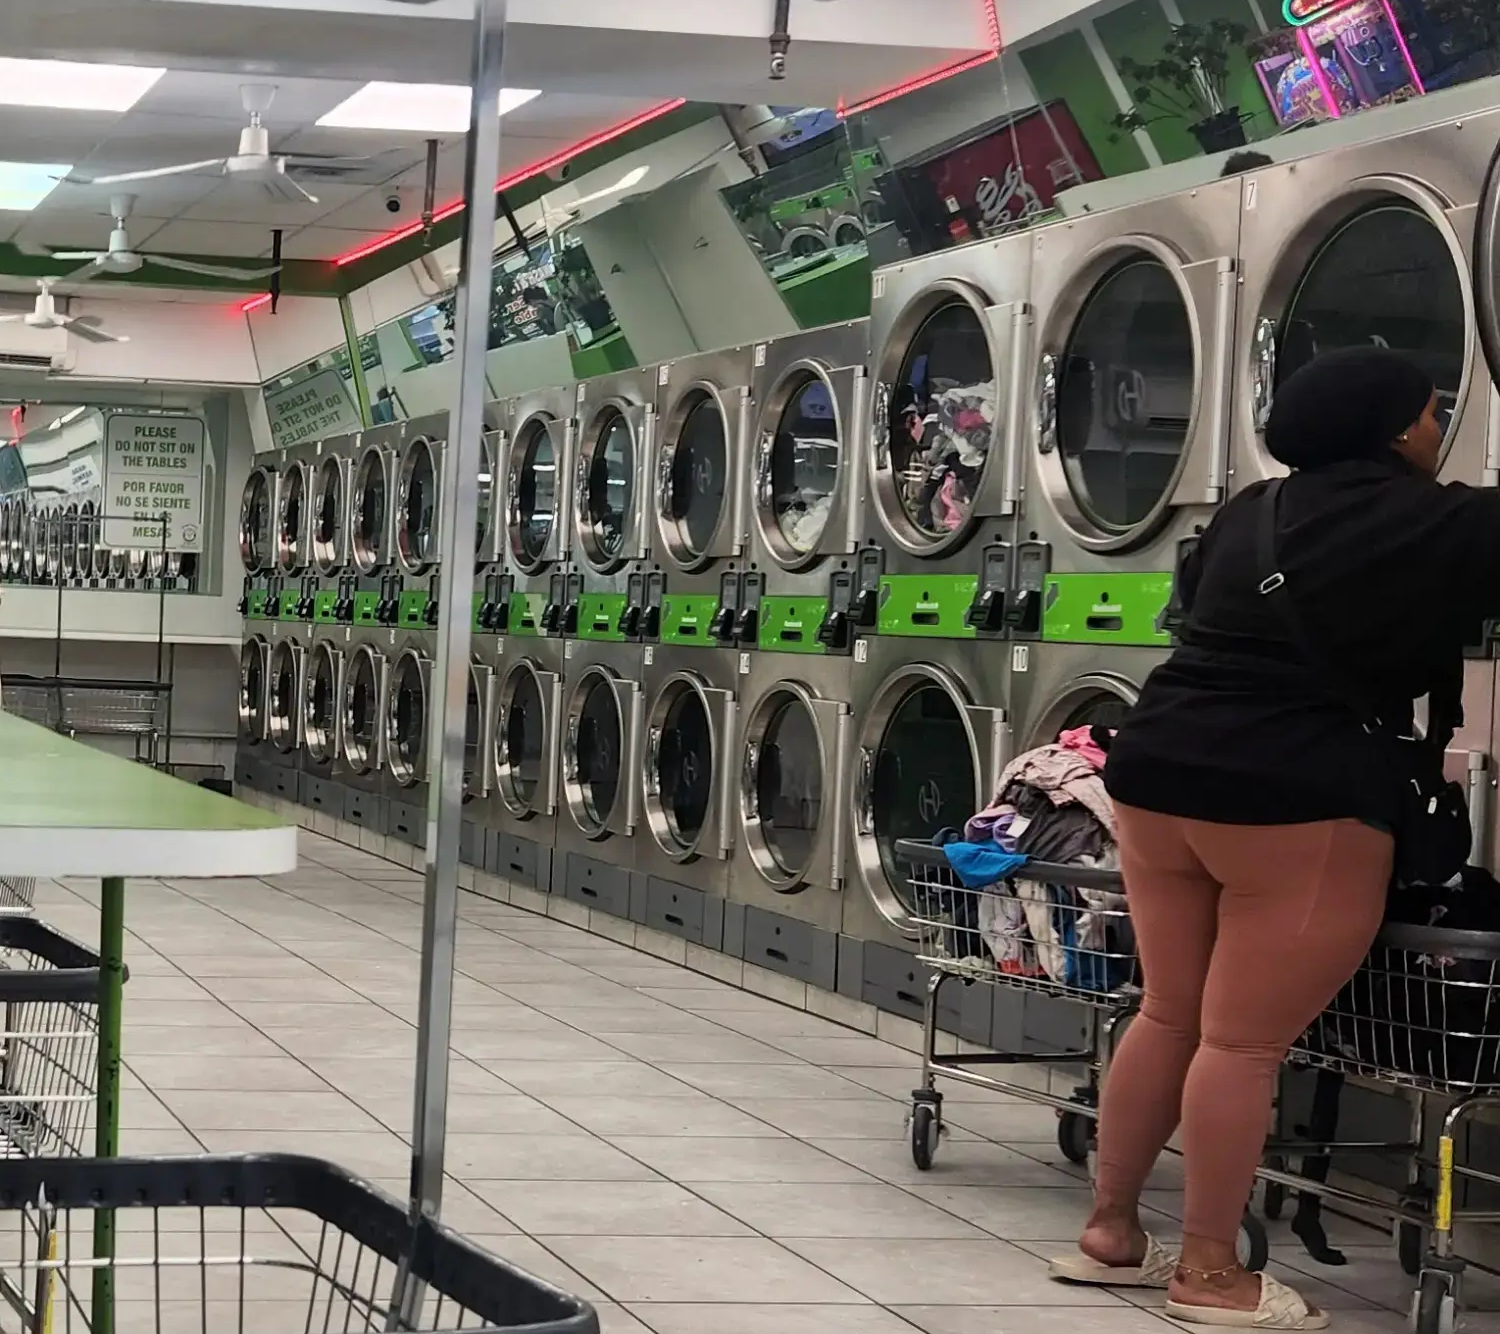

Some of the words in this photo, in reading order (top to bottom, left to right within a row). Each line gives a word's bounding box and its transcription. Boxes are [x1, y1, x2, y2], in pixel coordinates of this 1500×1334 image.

[135, 426, 177, 438] PLEASE
[115, 440, 130, 452] DO
[134, 441, 156, 453] NOT
[159, 442, 177, 454] SIT
[180, 443, 195, 454] ON
[122, 455, 143, 467] THE
[146, 456, 187, 469] TABLES
[123, 481, 145, 492] POR
[149, 482, 185, 494] FAVOR
[116, 496, 131, 507] NO
[135, 496, 149, 508] SE
[152, 497, 191, 509] SIENTE
